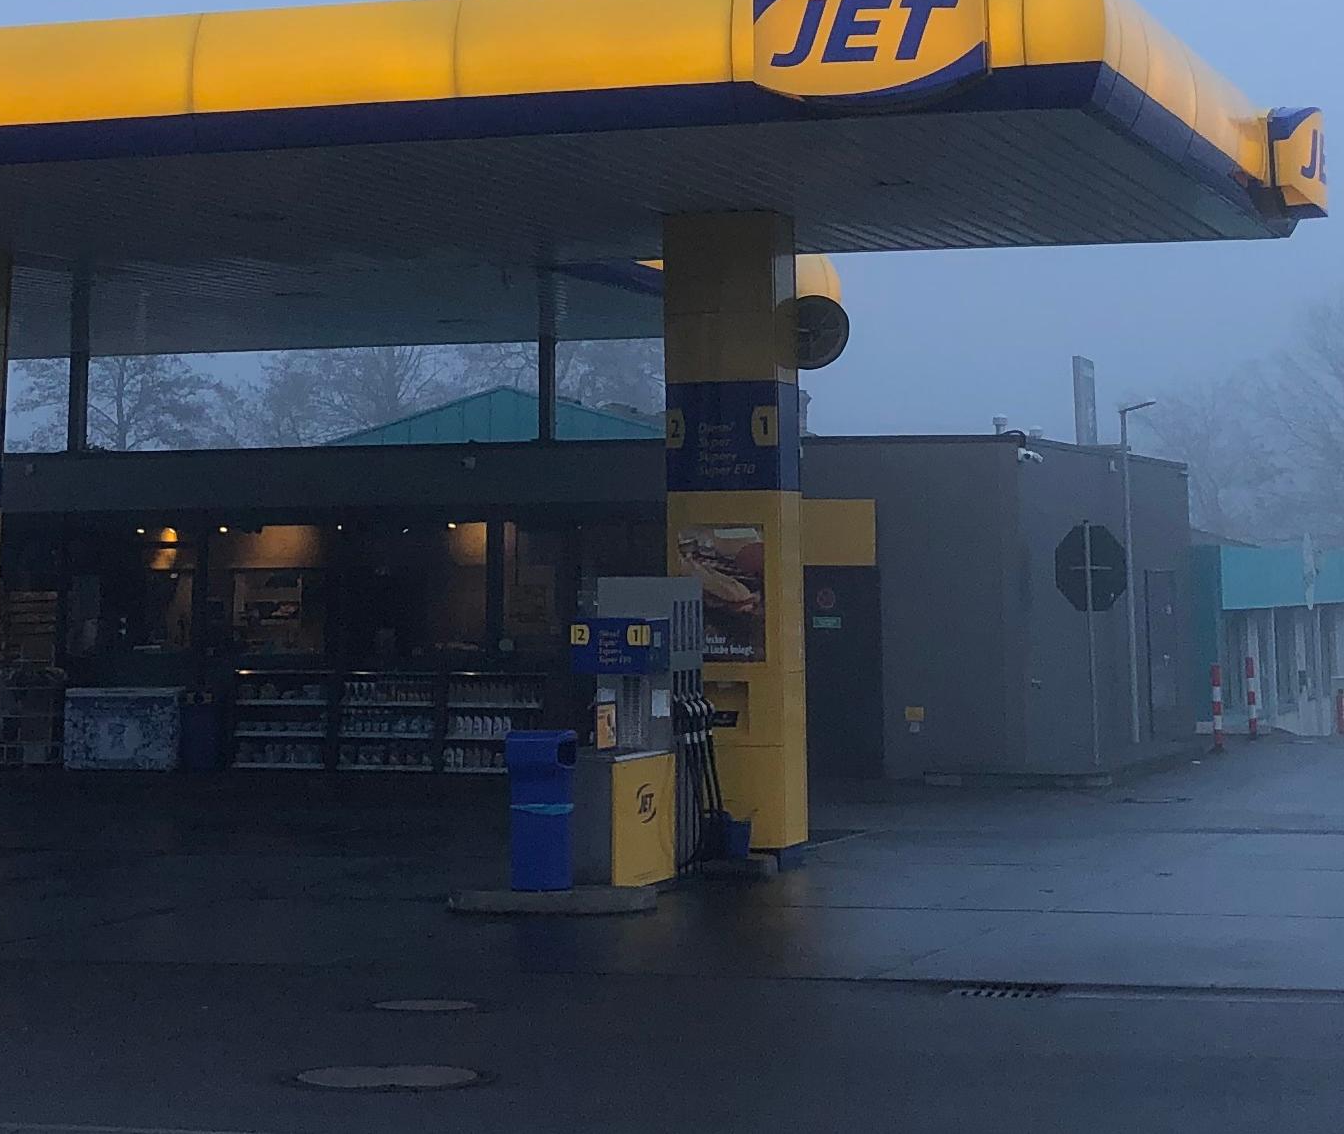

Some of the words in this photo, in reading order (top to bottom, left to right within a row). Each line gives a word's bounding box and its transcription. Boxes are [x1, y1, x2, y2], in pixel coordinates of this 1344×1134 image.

[670, 419, 681, 438] 2
[759, 416, 768, 435] 1
[577, 628, 586, 641] 2
